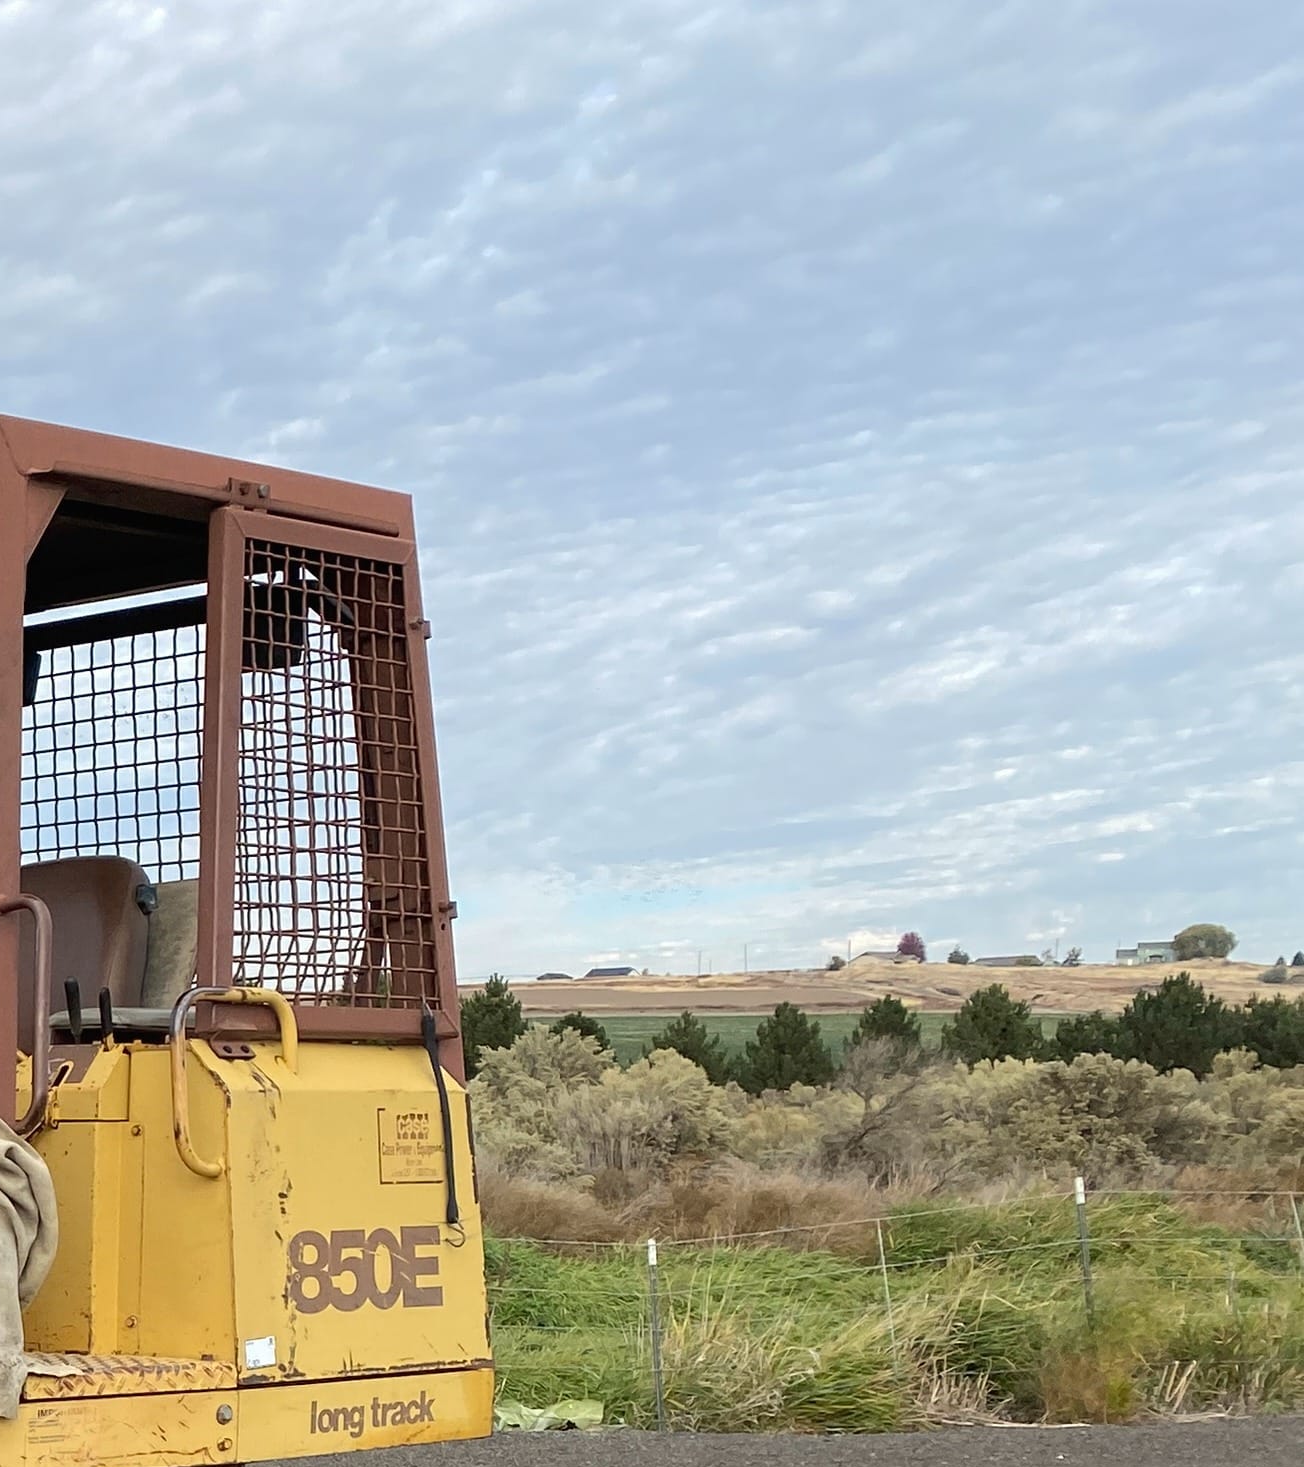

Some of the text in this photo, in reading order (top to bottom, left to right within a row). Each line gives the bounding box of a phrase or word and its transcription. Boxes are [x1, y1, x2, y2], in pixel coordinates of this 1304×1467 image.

[289, 1225, 444, 1314] 850E
[310, 1390, 435, 1438] long track
